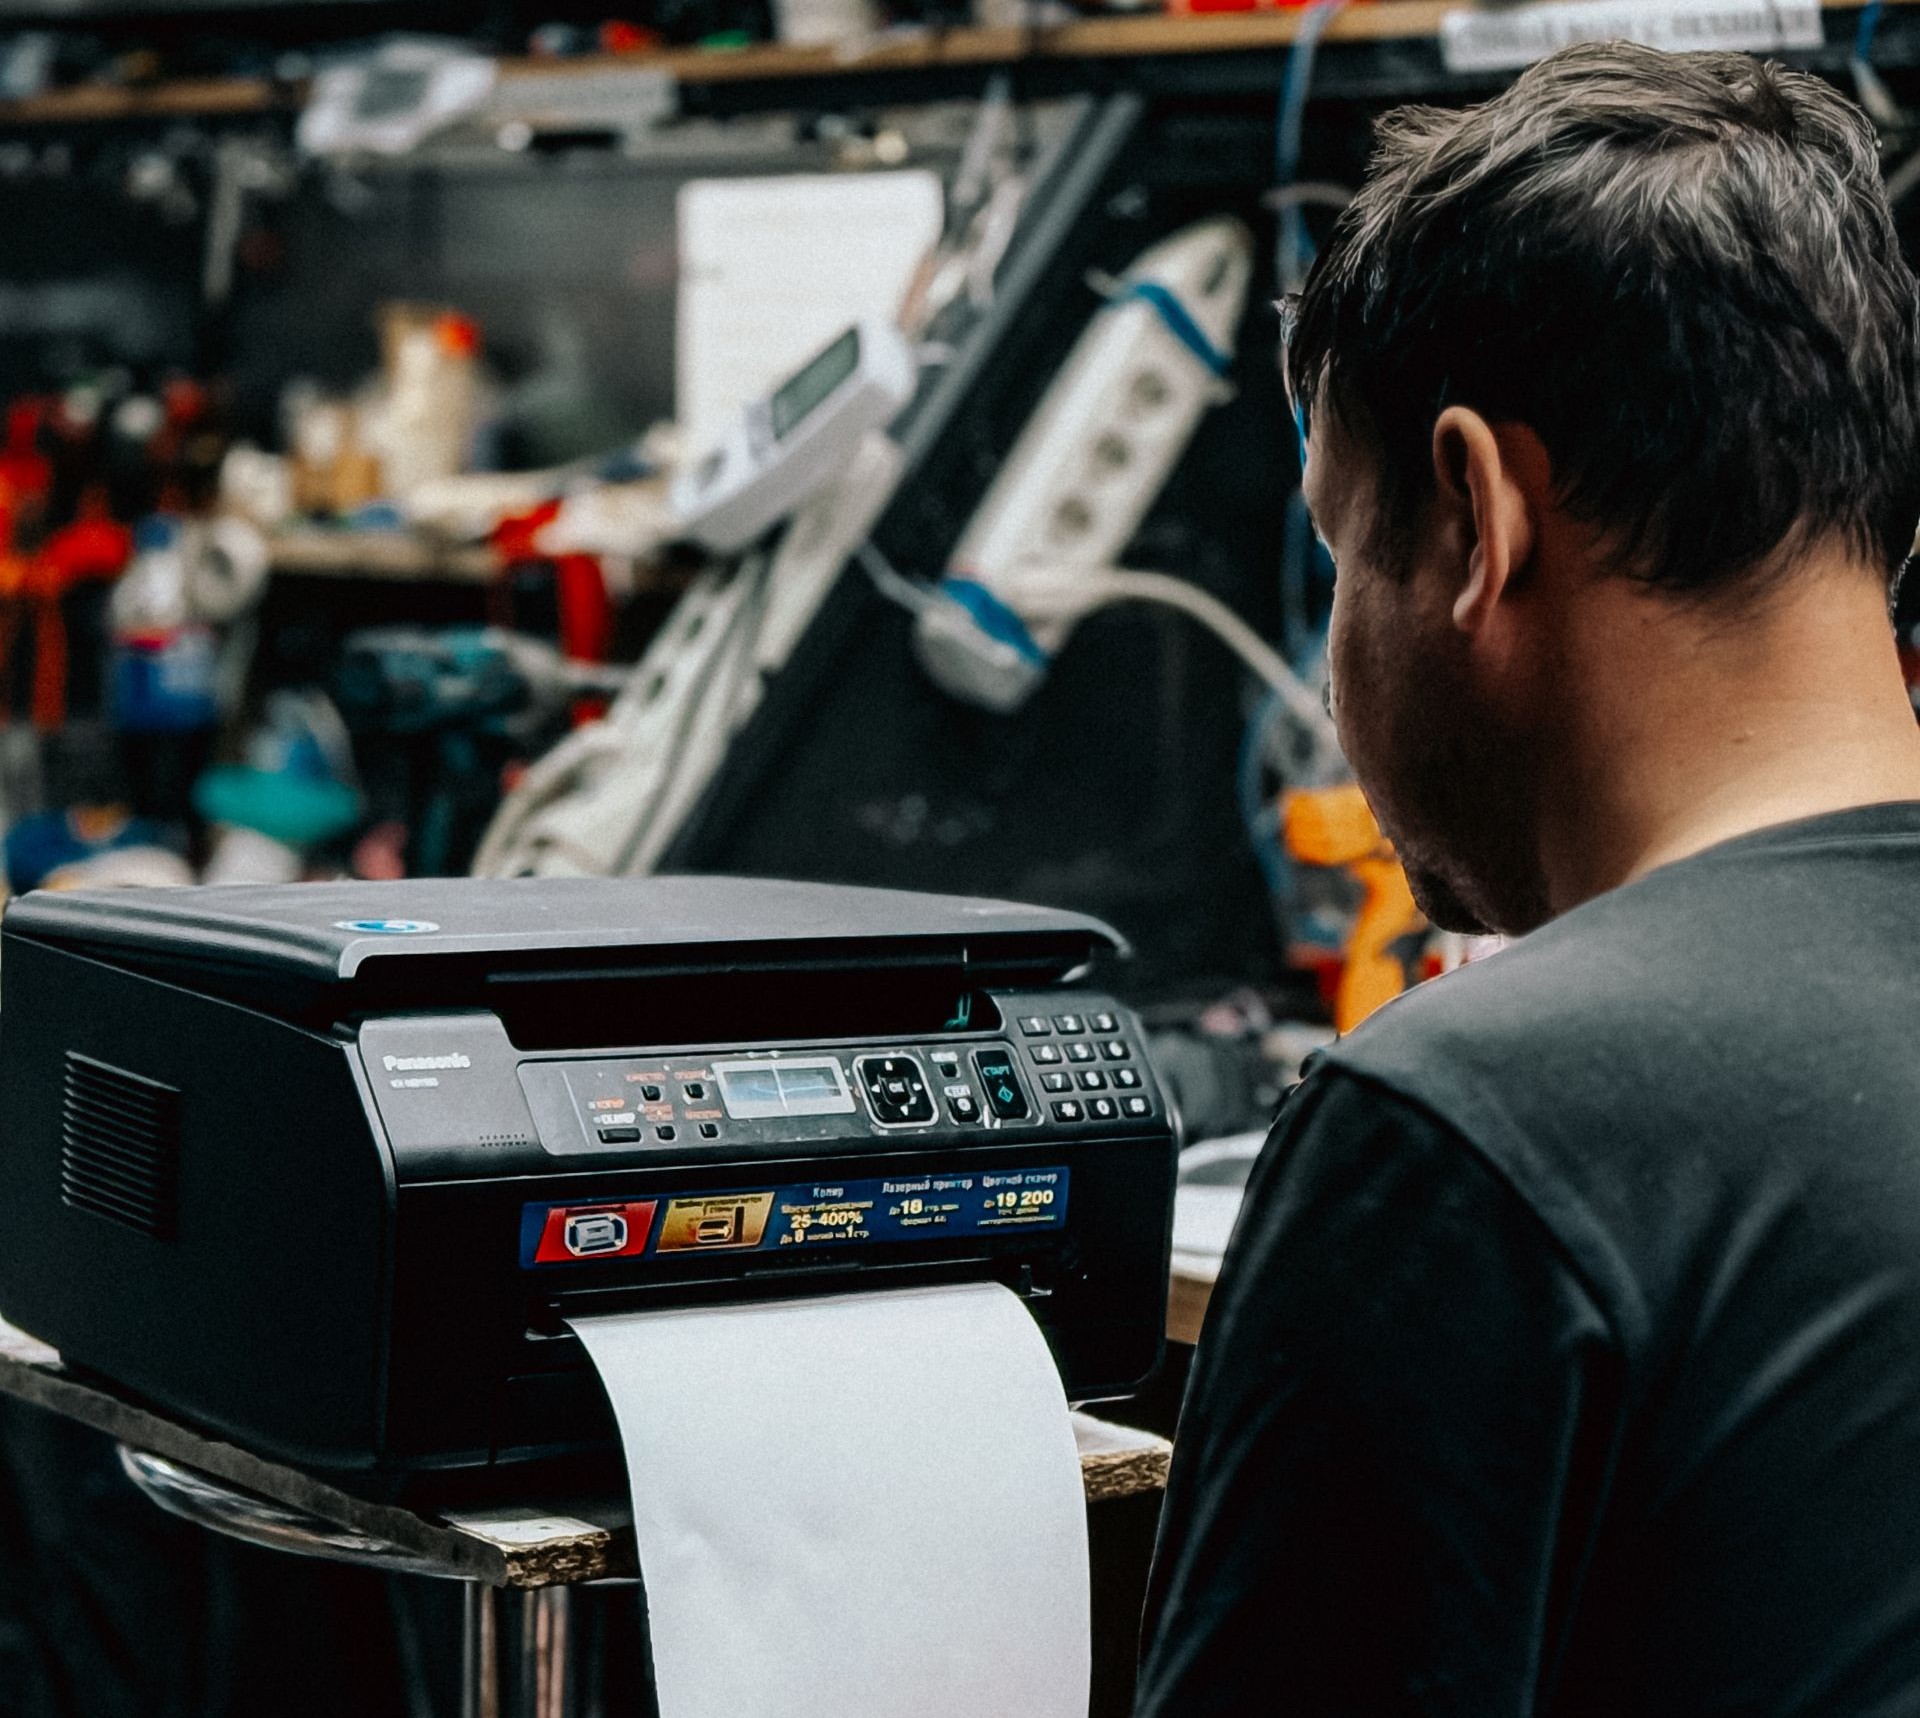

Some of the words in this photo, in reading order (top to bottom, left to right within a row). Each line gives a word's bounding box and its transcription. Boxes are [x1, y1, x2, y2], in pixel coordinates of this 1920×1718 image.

[1030, 1017, 1041, 1032] 1
[1063, 1015, 1078, 1031] 2
[1041, 1045, 1054, 1060] 4
[1074, 1043, 1088, 1059] 5
[383, 1052, 471, 1071] Panasonic
[1051, 1073, 1062, 1088] 7
[1096, 1099, 1110, 1115] 0
[882, 1180, 930, 1194] Лазерный
[932, 1179, 973, 1191] принтер
[982, 1174, 1023, 1188] Цветной
[1024, 1173, 1058, 1185] сканер
[813, 1187, 844, 1198] Копир
[901, 1198, 923, 1215] 18
